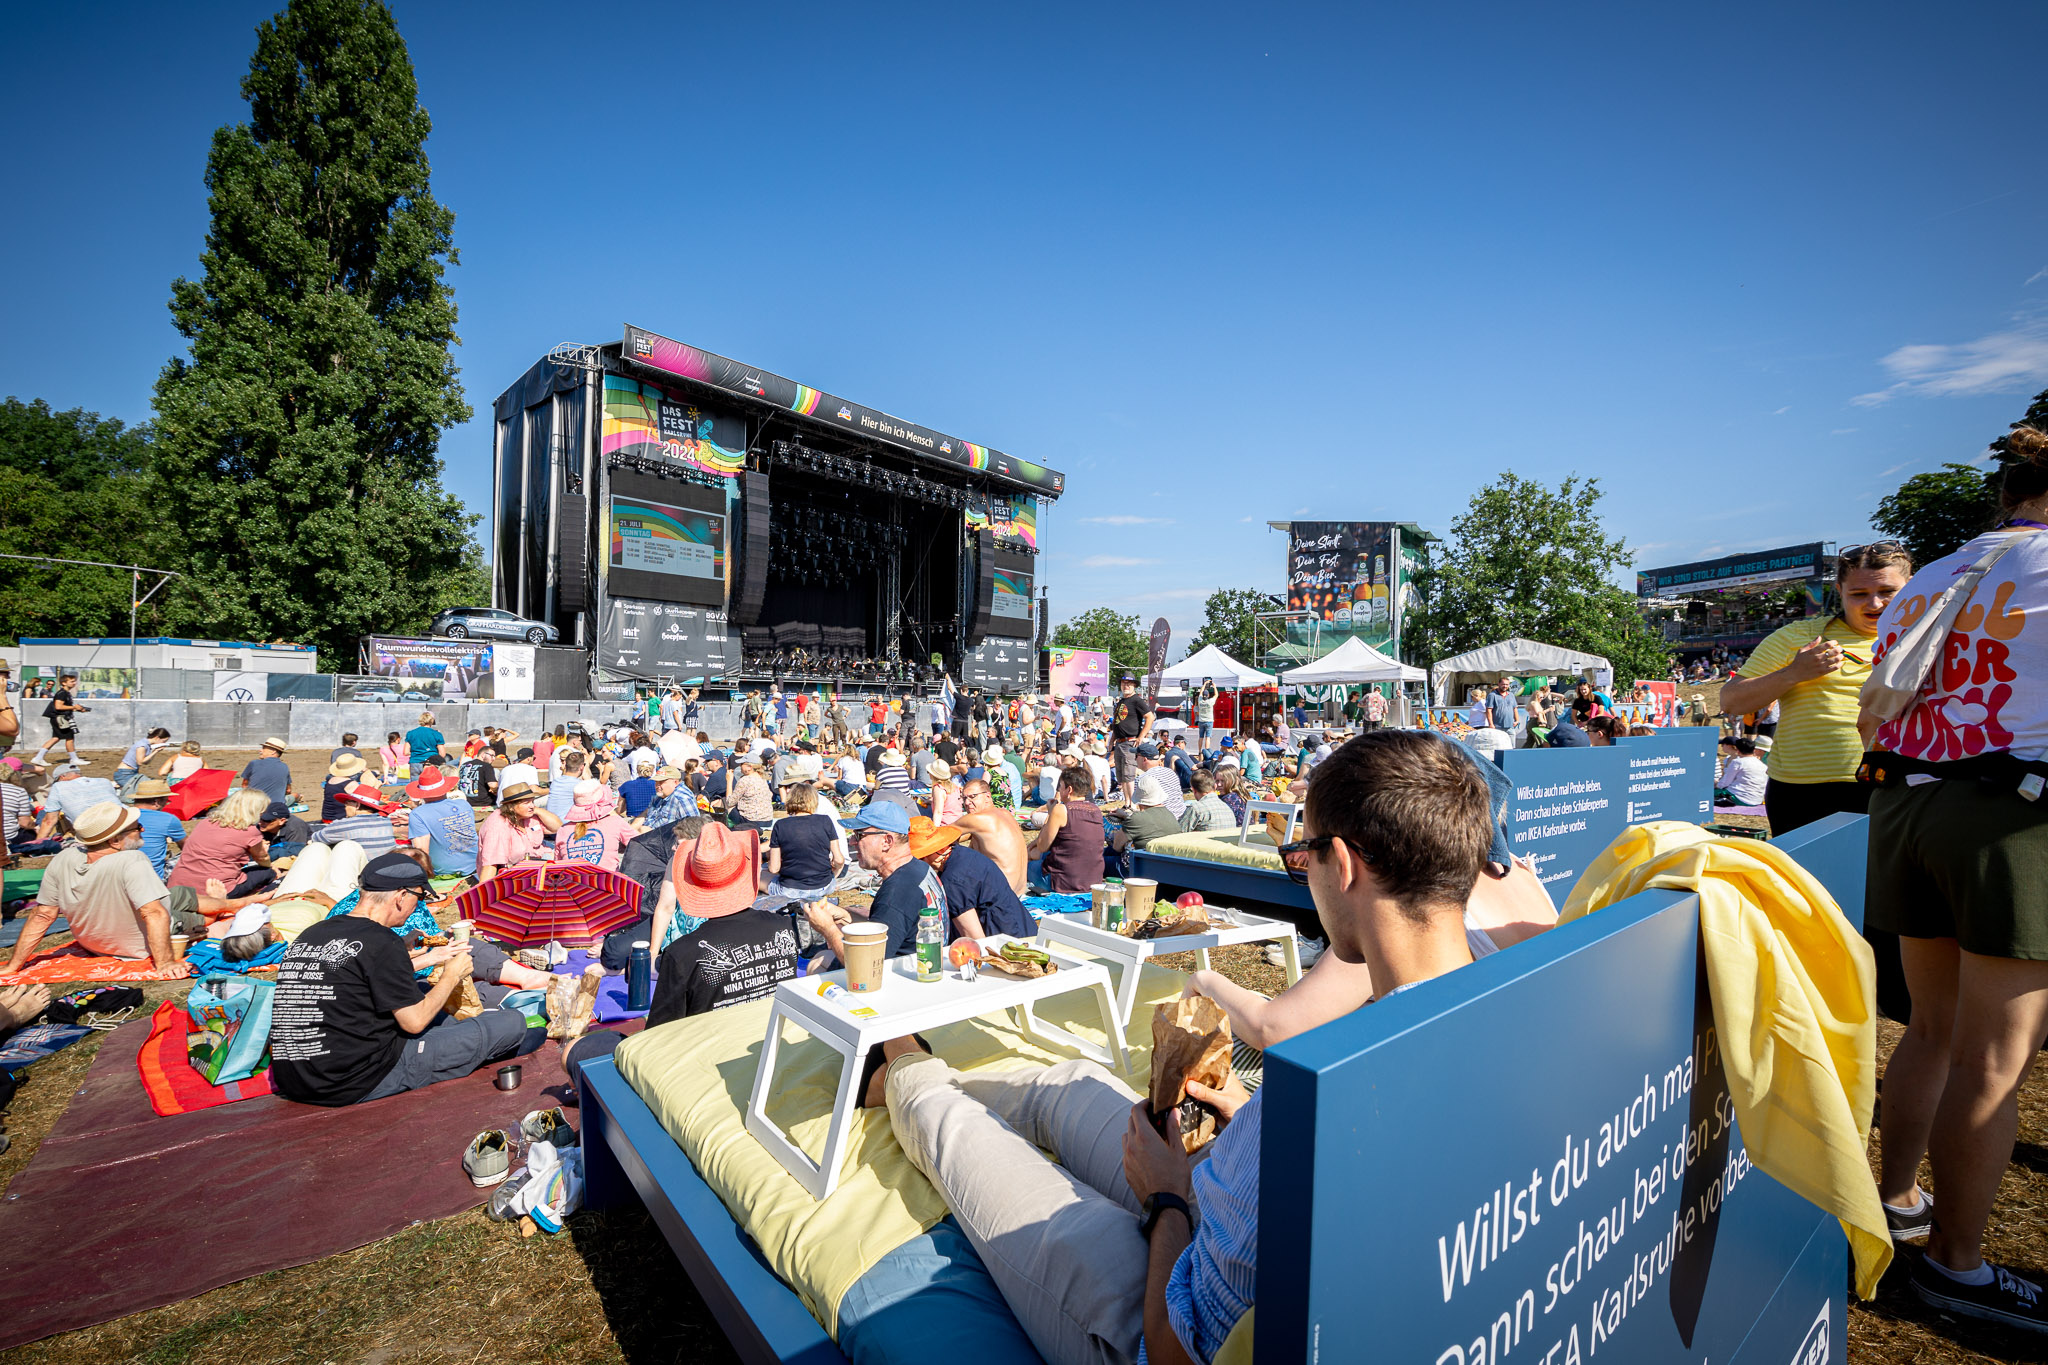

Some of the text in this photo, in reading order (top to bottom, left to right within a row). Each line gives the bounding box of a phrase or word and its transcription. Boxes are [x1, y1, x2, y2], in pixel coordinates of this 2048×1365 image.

[662, 405, 681, 417] DAS
[663, 416, 694, 432] FEST
[861, 415, 934, 448] Hier bin ich Mensch
[662, 440, 696, 463] 2024
[994, 506, 1010, 515] FEST
[629, 520, 641, 528] JULI
[995, 523, 1010, 537] 2024
[620, 529, 651, 537] SONNTAG
[1294, 538, 1316, 552] Deine
[1295, 552, 1341, 569] Dein Fest.
[1659, 575, 1672, 585] WIR
[1673, 572, 1691, 584] SIND
[1692, 568, 1715, 581] STOLZ
[1717, 565, 1732, 577] AUF
[1734, 561, 1767, 575] UNSERE
[1769, 553, 1814, 570] PARTNER!
[1294, 569, 1337, 584] Dein Bier.
[375, 643, 490, 655] Raumwundervollelektrisch
[1517, 785, 1534, 801] Willst
[1535, 785, 1543, 798] du
[1544, 783, 1558, 797] auch
[1559, 782, 1570, 796] mal
[1570, 780, 1585, 794] Probe
[1516, 798, 1609, 822] Dann schau bei den Schlafexperten
[1515, 818, 1587, 843] von IKEA Karlsruhe vorbei.
[307, 962, 320, 971] LEA
[730, 958, 789, 981] PETER FOX LEA
[302, 971, 325, 981] BOSSE
[723, 980, 744, 995] NINA
[744, 974, 769, 990] CHUBA
[775, 966, 795, 980] BOSSE
[1438, 1168, 1542, 1304] Willst
[1550, 1134, 1590, 1208] du
[1596, 1073, 1657, 1169] auch
[1662, 1034, 1700, 1112] mal
[1543, 1206, 1626, 1315] schau
[1632, 1143, 1667, 1224] bei
[1672, 1117, 1709, 1182] den
[1590, 1208, 1695, 1358] Karlsruhe
